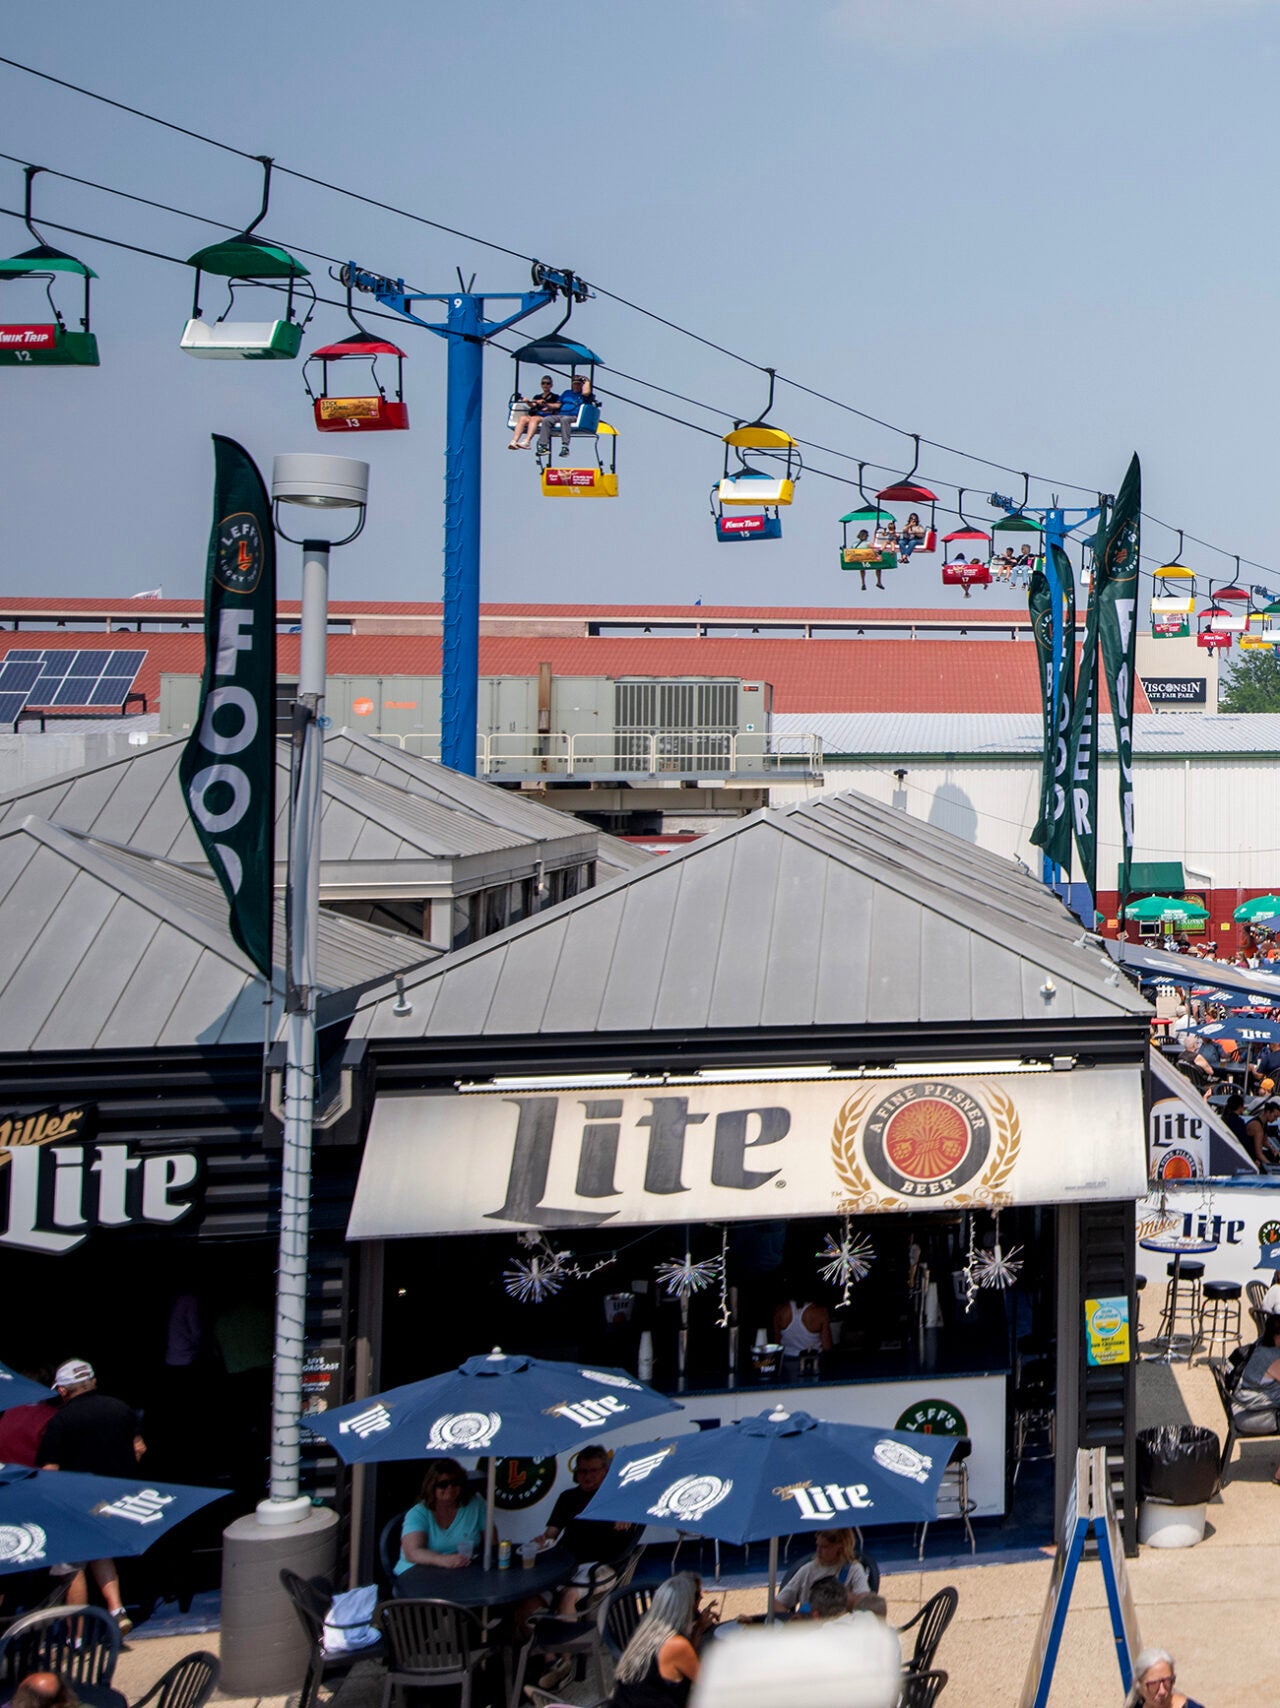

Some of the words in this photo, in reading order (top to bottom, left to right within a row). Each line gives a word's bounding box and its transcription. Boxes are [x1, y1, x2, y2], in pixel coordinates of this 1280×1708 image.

[454, 298, 462, 308] 9
[24, 331, 48, 342] TRIP
[14, 350, 32, 361] 12
[346, 418, 360, 427] 13
[1209, 991, 1234, 1000] Lite
[1241, 1029, 1272, 1040] Lite
[870, 1122, 882, 1134] A
[877, 1088, 917, 1119] FINE
[923, 1084, 986, 1129] PILSNER
[1152, 1113, 1202, 1147] Lite
[482, 1096, 792, 1228] Lite
[0, 1145, 198, 1250] Lite
[900, 1178, 956, 1196] BEER
[339, 1404, 392, 1439] Lite
[556, 1395, 628, 1428] Lite
[906, 1408, 956, 1431] LEFF'S
[99, 1489, 172, 1525] Lite
[792, 1482, 873, 1520] Lite
